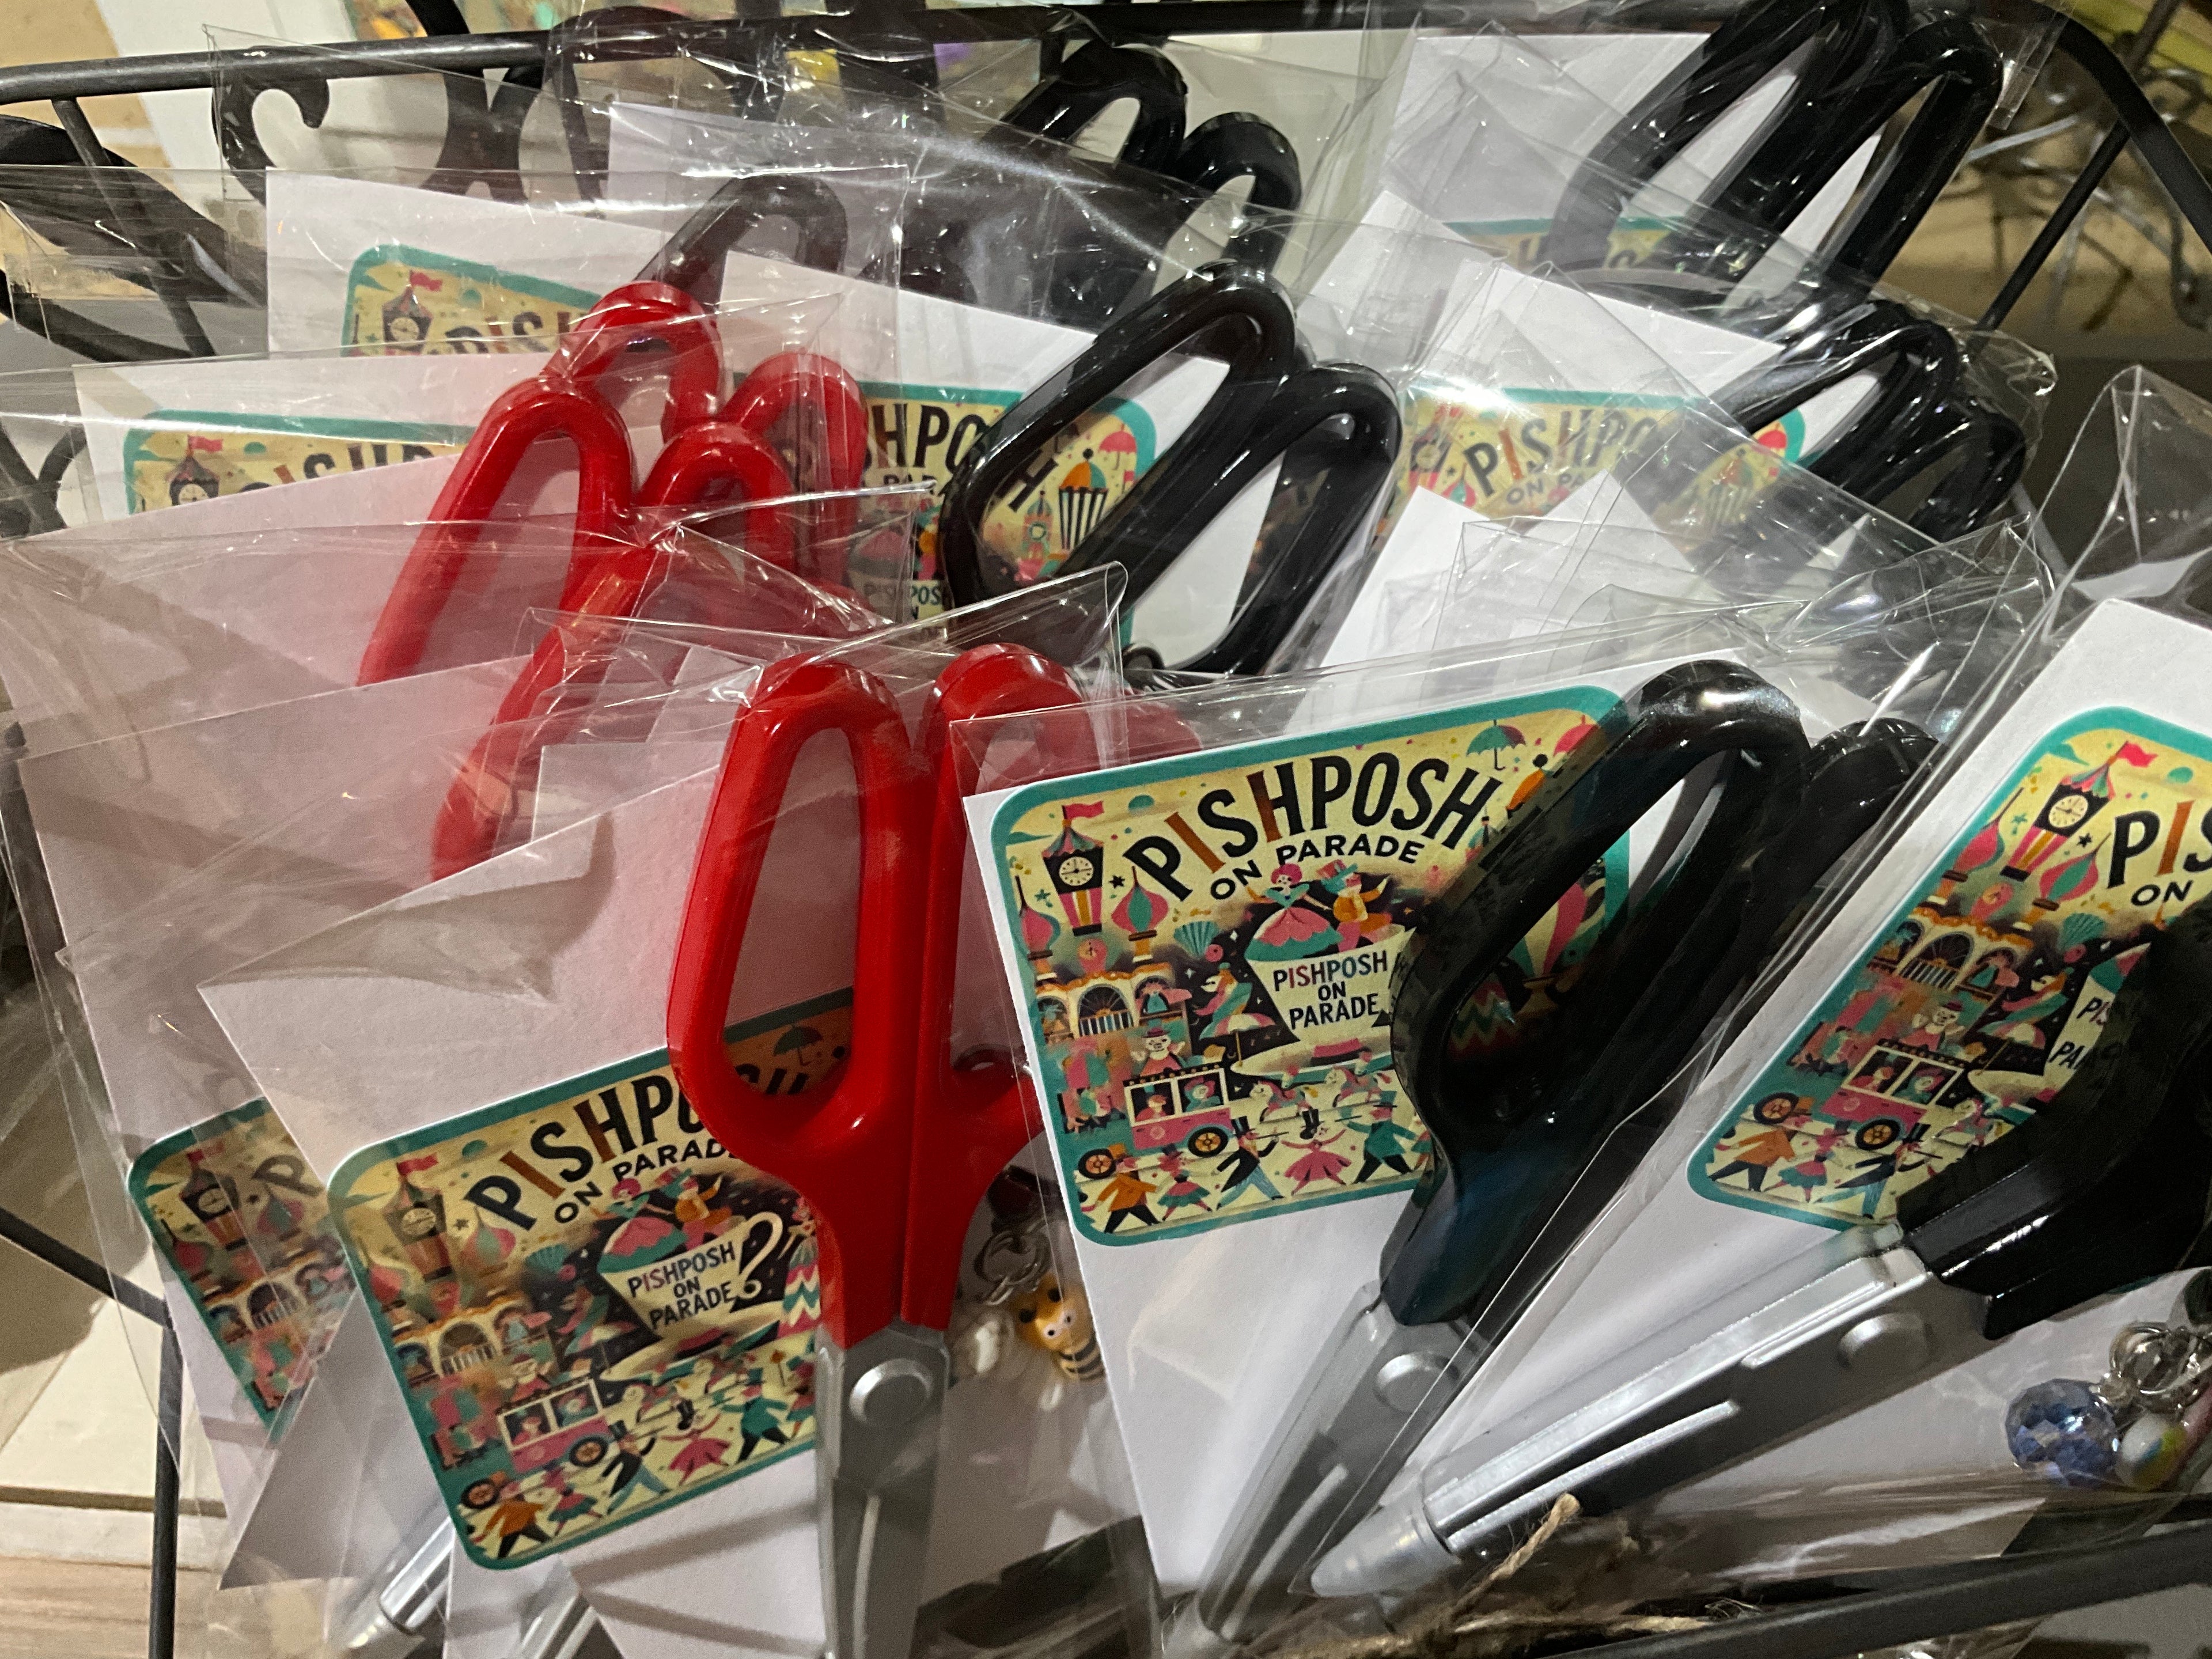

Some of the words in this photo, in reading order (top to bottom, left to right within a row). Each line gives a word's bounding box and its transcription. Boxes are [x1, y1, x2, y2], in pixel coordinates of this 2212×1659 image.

[1506, 479, 1546, 505] ON
[1123, 752, 1502, 901] PISHPOSH
[1210, 859, 1262, 900] ON
[1276, 833, 1425, 864] PARADE
[2131, 880, 2194, 906] ON
[1273, 950, 1387, 992] PISHPOSH
[1318, 981, 1346, 1001] ON
[1289, 993, 1378, 1030] PARADE
[554, 1181, 603, 1225] ON
[613, 1139, 735, 1179] PARAD
[627, 1241, 736, 1297] PISHPOSH
[673, 1276, 701, 1298] ON
[649, 1281, 737, 1330] PARADE
